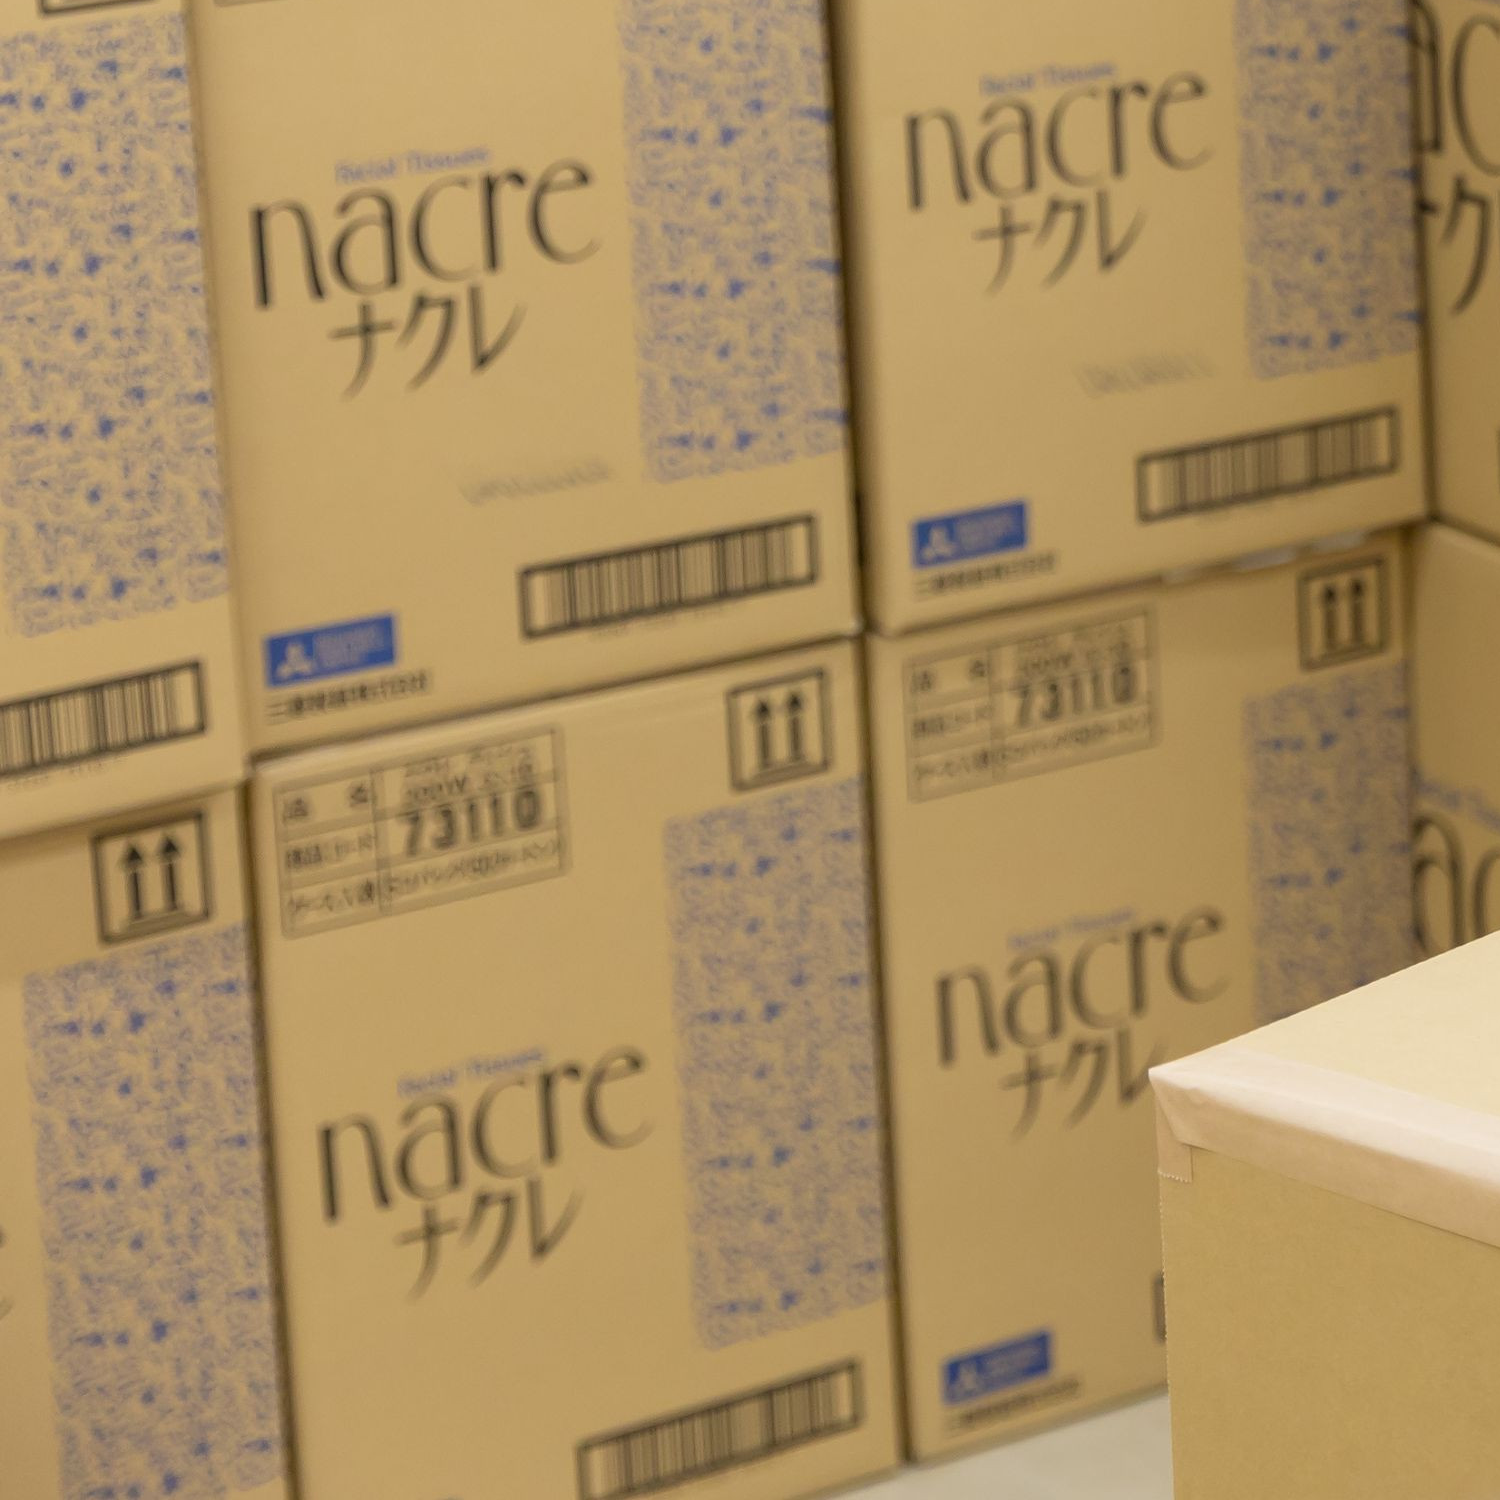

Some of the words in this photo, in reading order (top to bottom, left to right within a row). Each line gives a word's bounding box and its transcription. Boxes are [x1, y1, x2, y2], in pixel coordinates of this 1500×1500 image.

[902, 70, 1214, 212] nacre
[246, 156, 606, 312] nacre
[971, 188, 1149, 297] ナクレ
[326, 281, 529, 402] ナクレ
[397, 787, 543, 859] 73110
[934, 902, 1232, 1070] nacre
[315, 1045, 657, 1227] nacre
[394, 1178, 586, 1301] ナクレ
